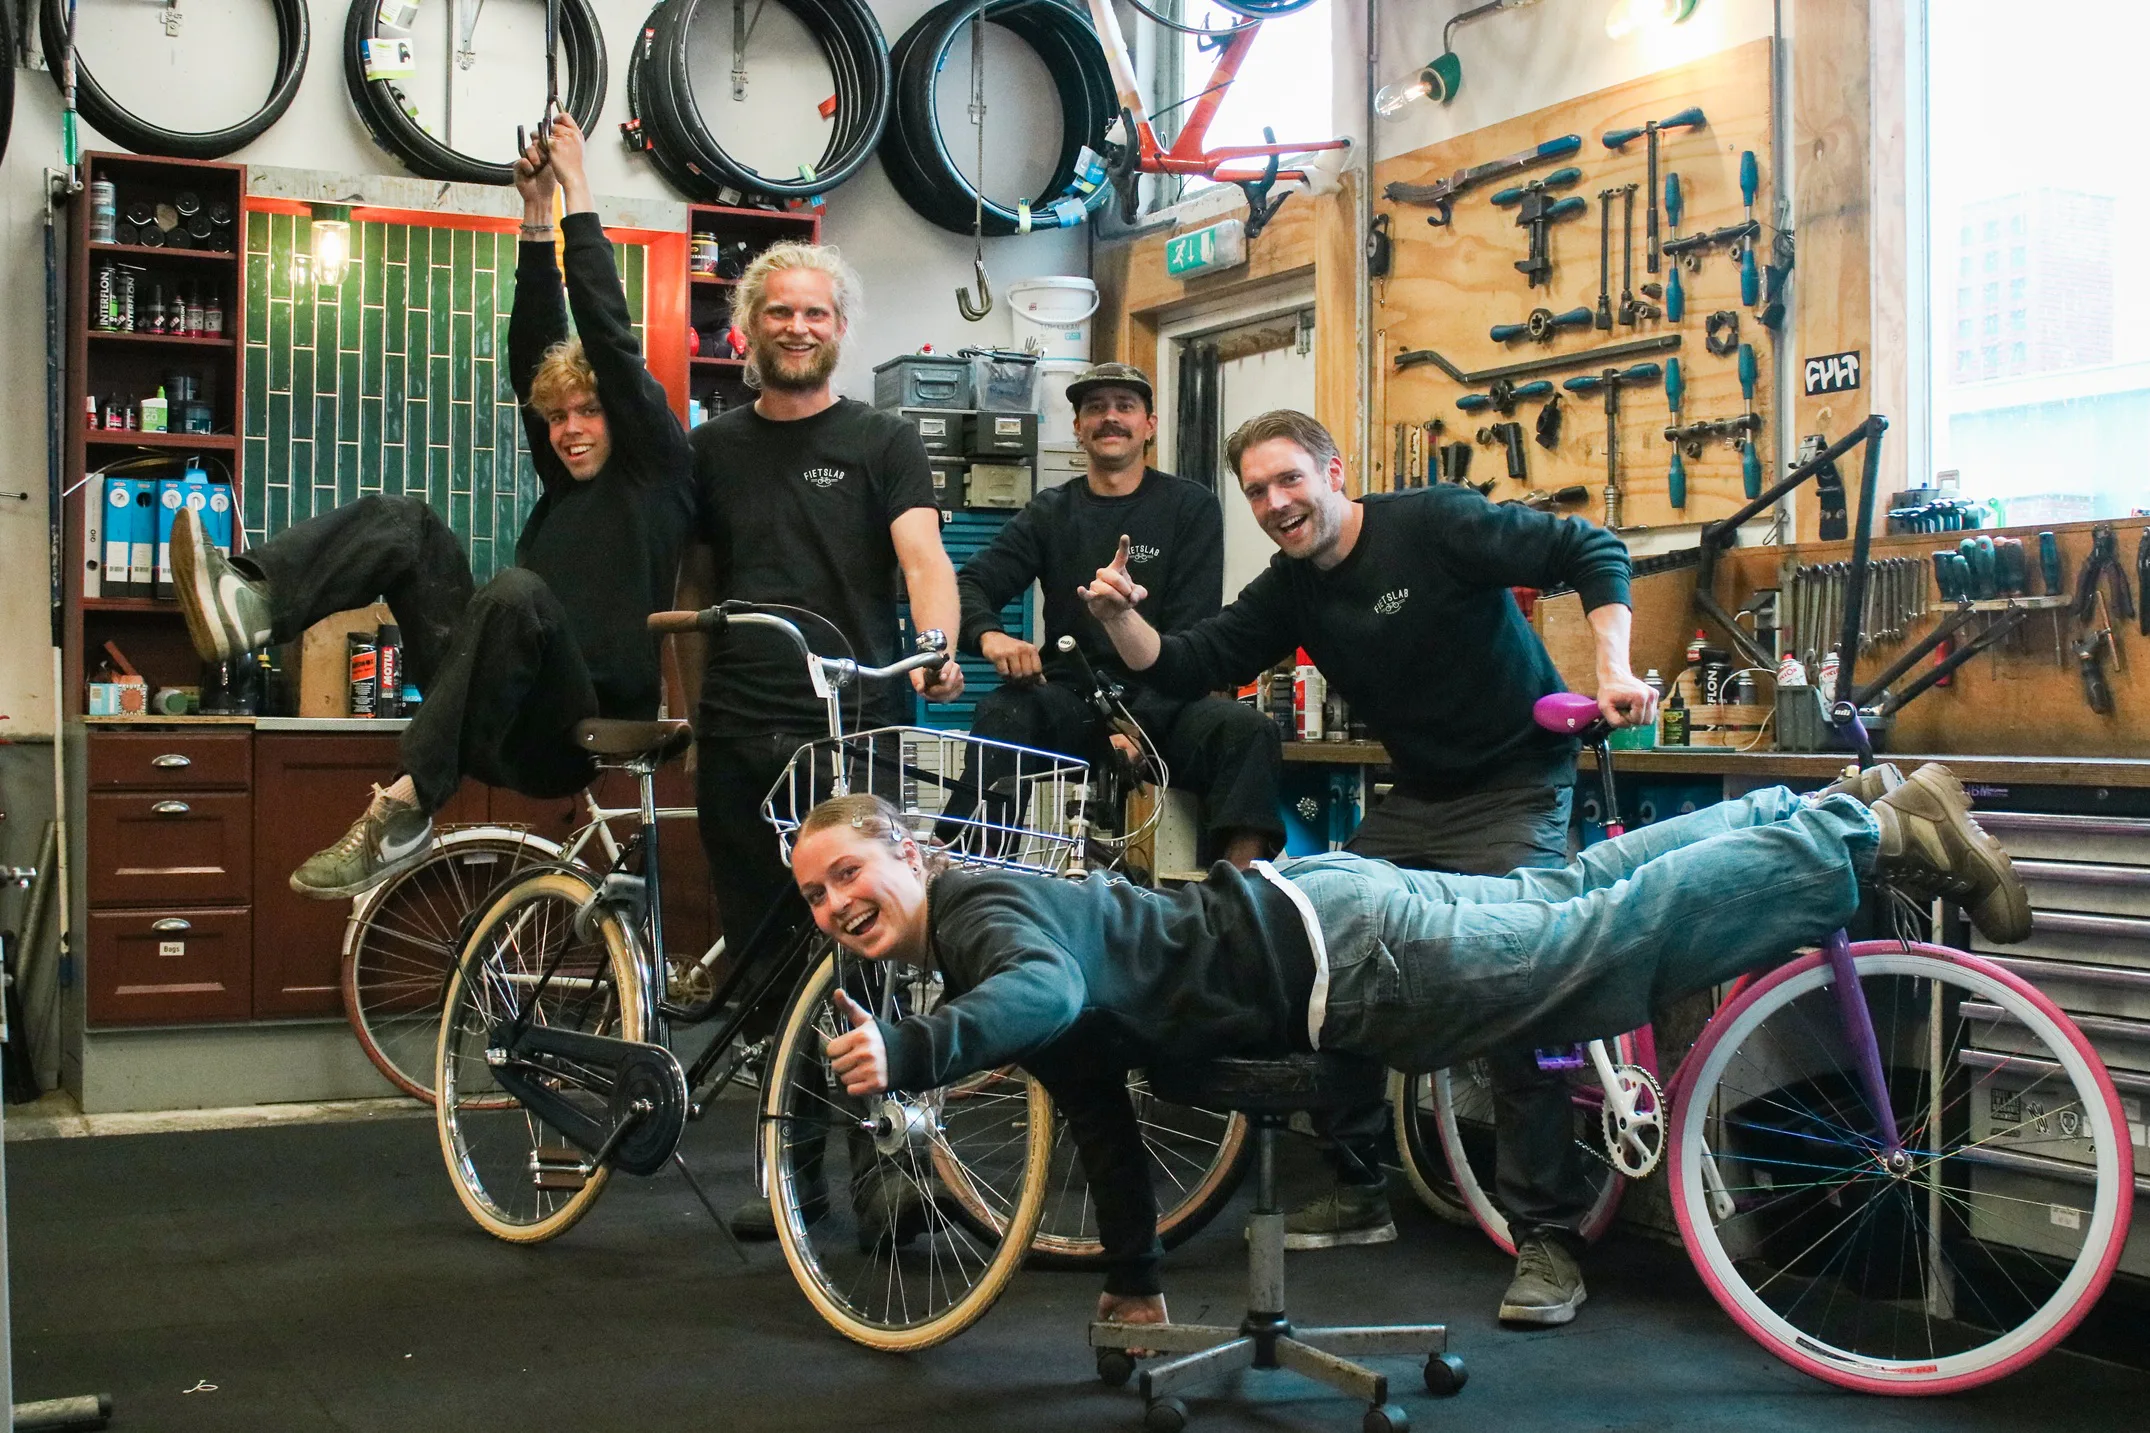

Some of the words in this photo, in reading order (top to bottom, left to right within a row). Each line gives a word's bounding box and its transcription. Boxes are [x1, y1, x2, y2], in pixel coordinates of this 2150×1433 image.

[100, 271, 110, 325] INTERFLON
[127, 276, 135, 331] INTERFLON
[803, 468, 845, 481] FIETSLAB
[1129, 545, 1160, 557] ETSLAB
[1374, 588, 1409, 614] FIETSLAB
[383, 648, 393, 686] MOTUL
[163, 945, 180, 954] Bags
